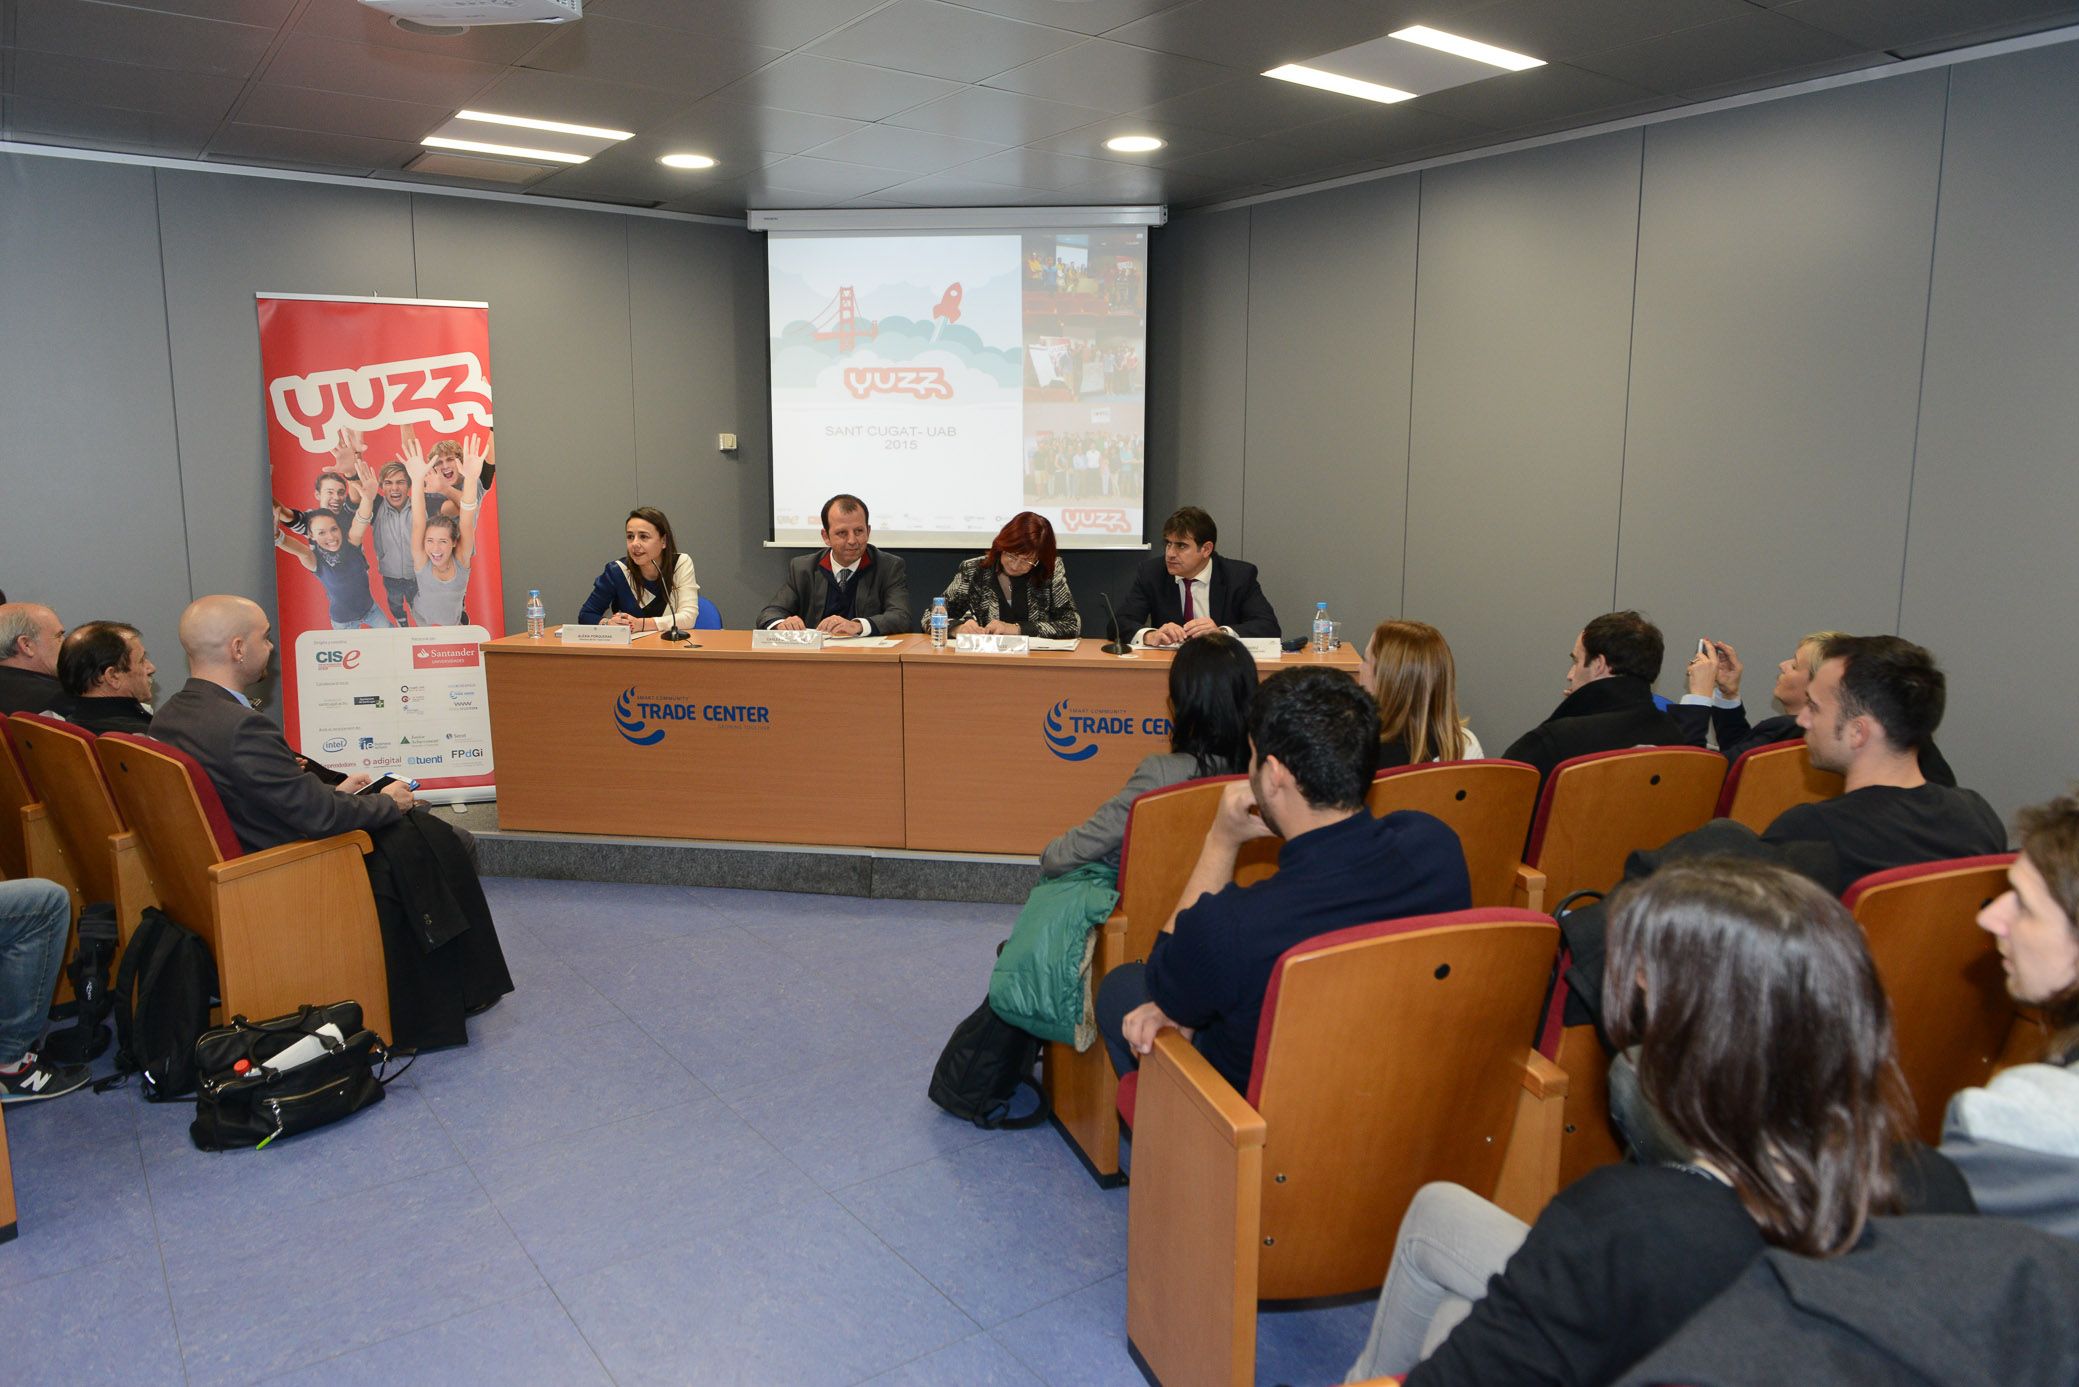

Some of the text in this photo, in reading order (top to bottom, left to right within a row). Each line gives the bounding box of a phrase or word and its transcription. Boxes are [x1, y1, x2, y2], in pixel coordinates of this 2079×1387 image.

[825, 426, 862, 436] SANT
[927, 426, 957, 437] UAB
[885, 440, 918, 449] 2015
[431, 648, 475, 658] Santander
[637, 703, 770, 723] TRADE CENTER
[1069, 716, 1174, 735] TRADE CEN
[325, 739, 344, 750] intel
[451, 748, 483, 758] FPdGi
[373, 756, 402, 765] adigital
[416, 755, 443, 764] tuenti
